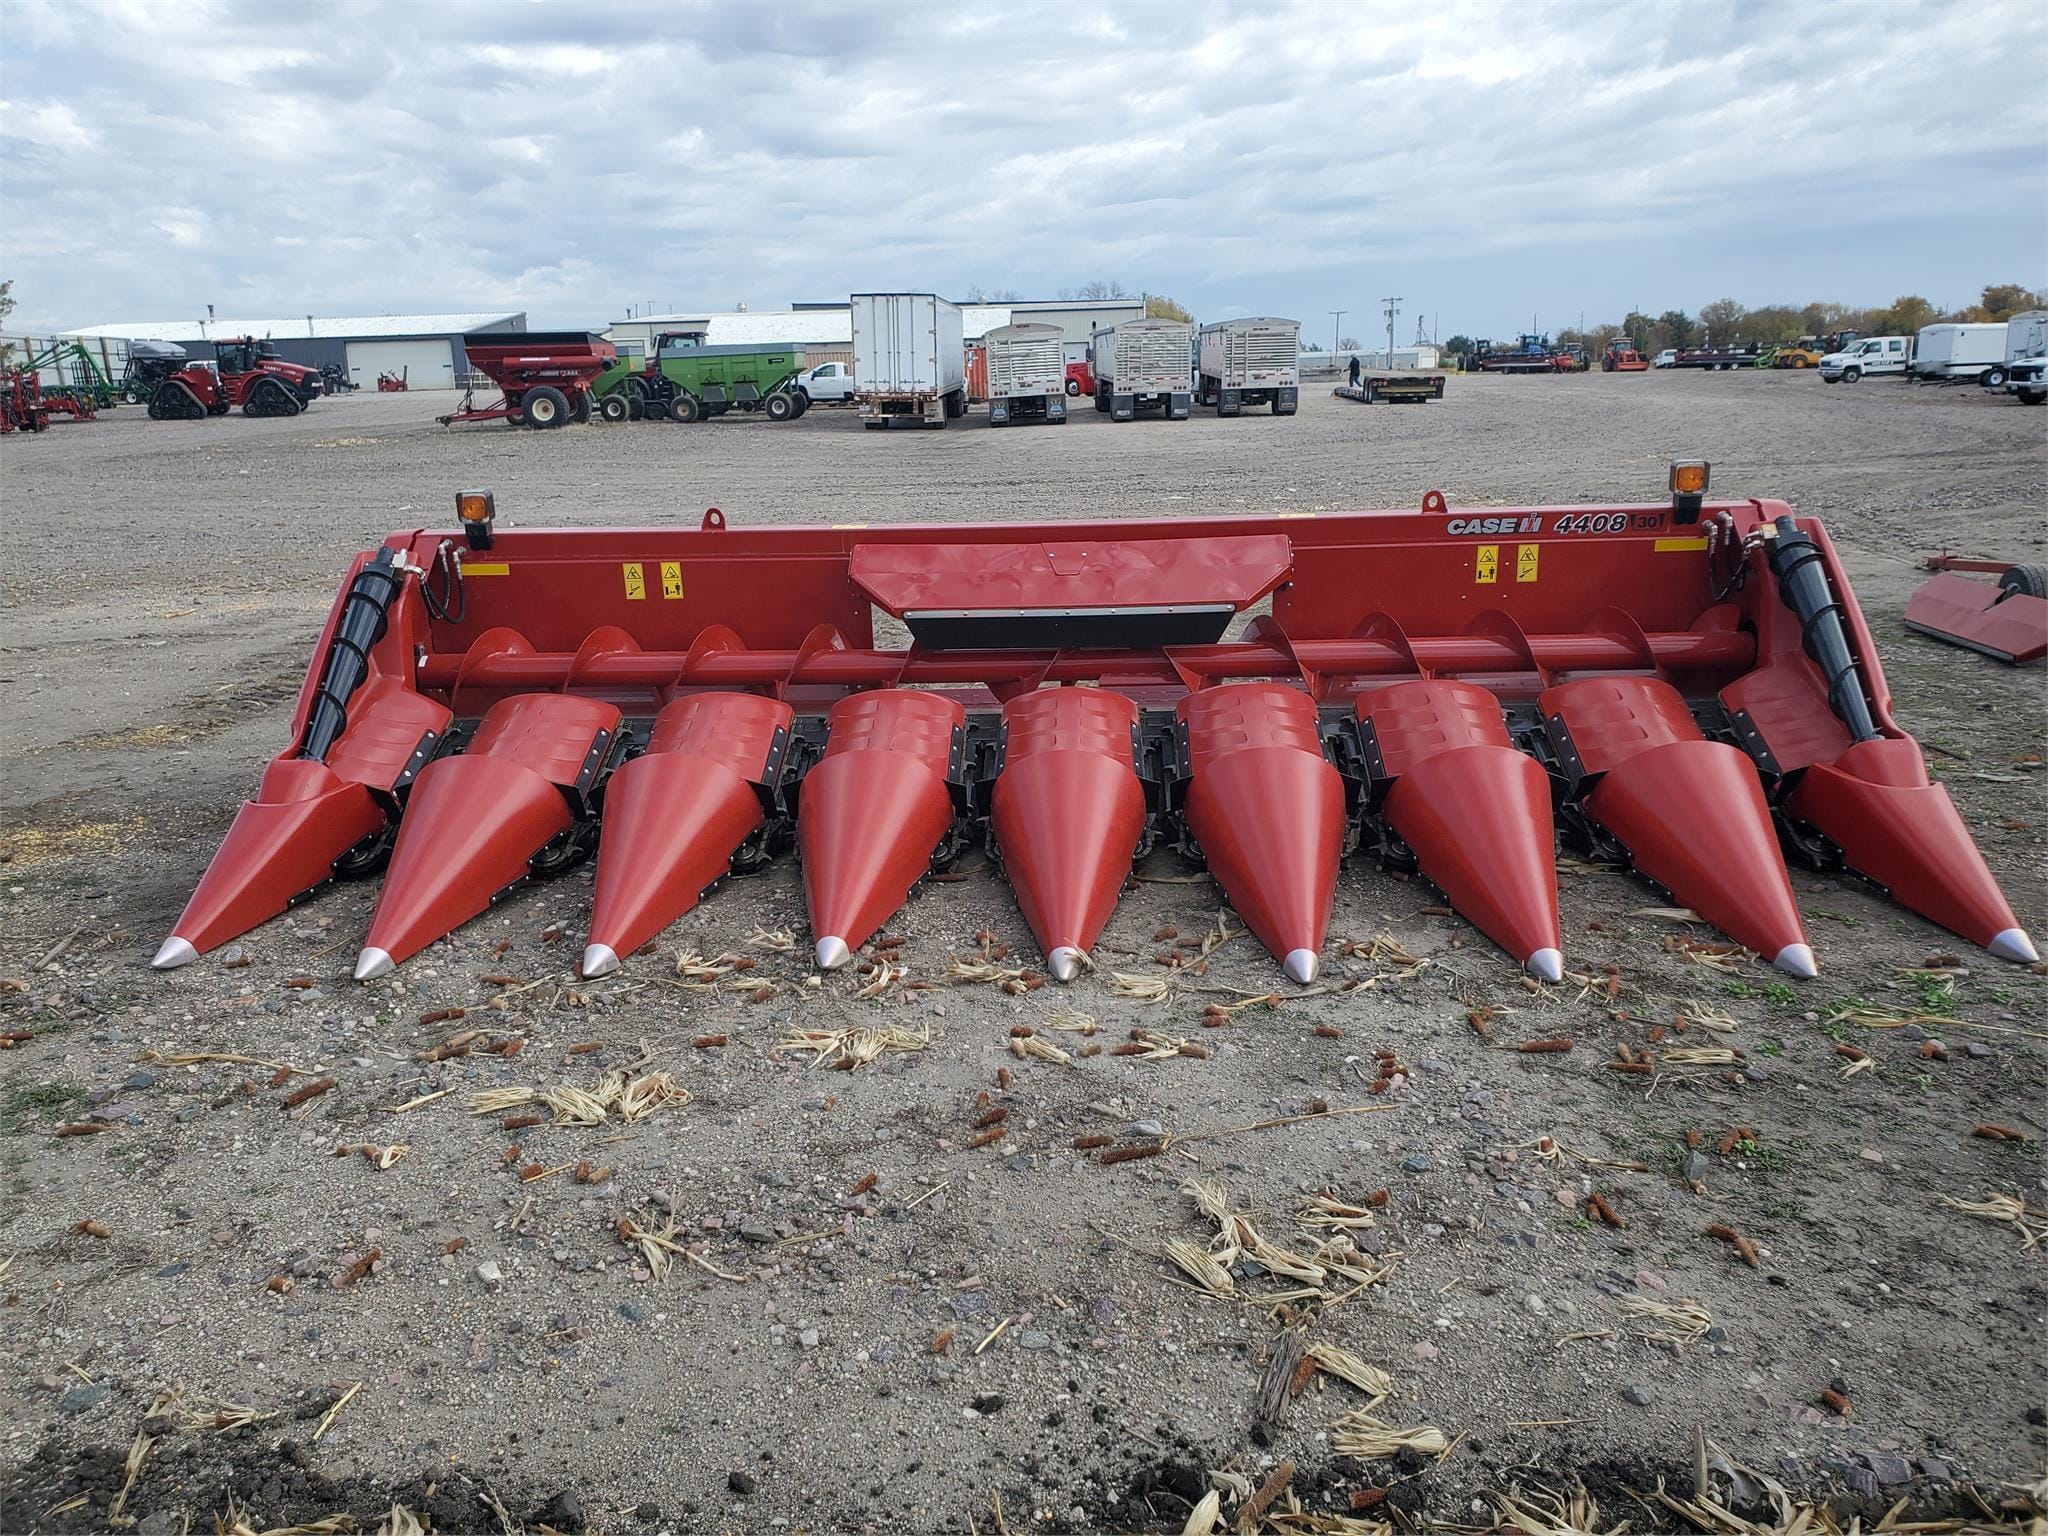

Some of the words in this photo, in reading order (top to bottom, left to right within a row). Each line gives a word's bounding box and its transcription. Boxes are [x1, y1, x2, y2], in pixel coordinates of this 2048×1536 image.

[1446, 517, 1514, 535] CASE
[1553, 513, 1628, 534] 4408
[1637, 515, 1656, 529] 30
